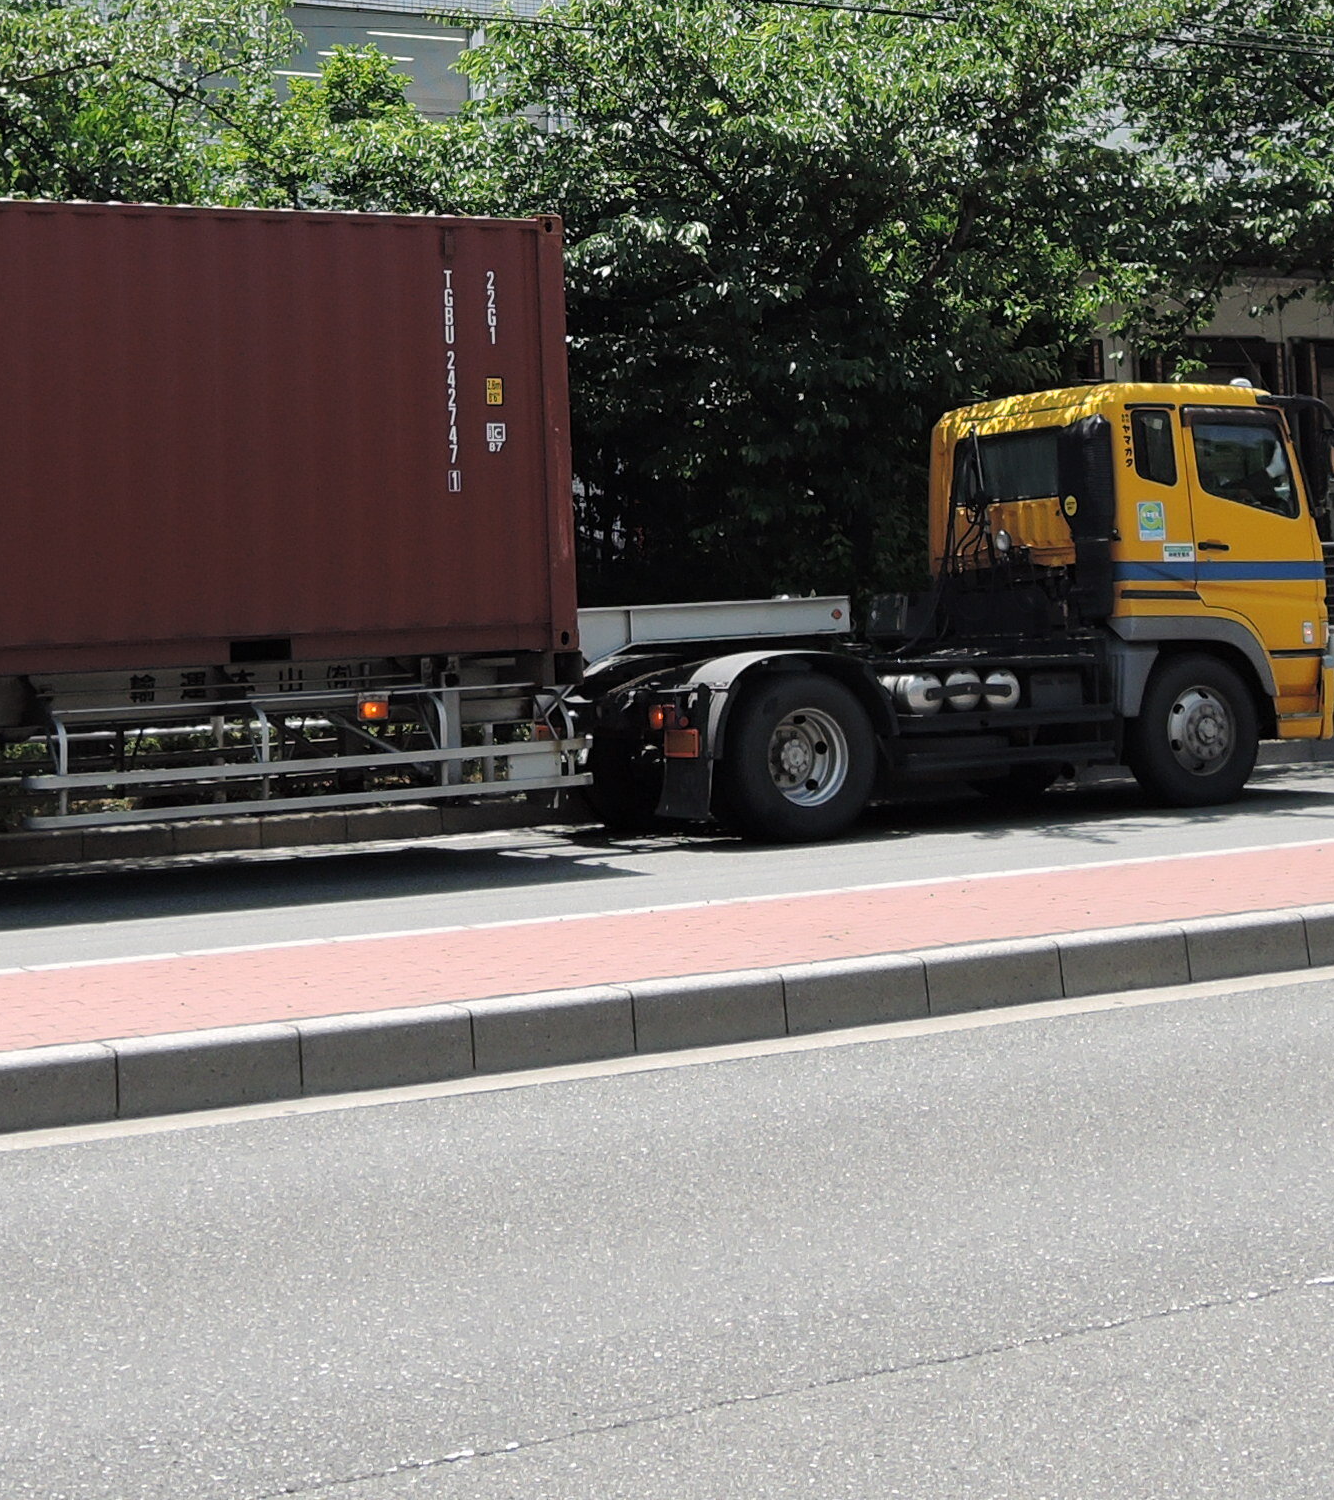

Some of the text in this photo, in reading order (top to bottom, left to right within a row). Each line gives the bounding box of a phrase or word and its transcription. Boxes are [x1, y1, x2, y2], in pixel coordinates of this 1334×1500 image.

[443, 269, 455, 344] TGBU
[486, 271, 497, 345] 22G1
[446, 350, 458, 464] 242747
[489, 442, 503, 452] 87
